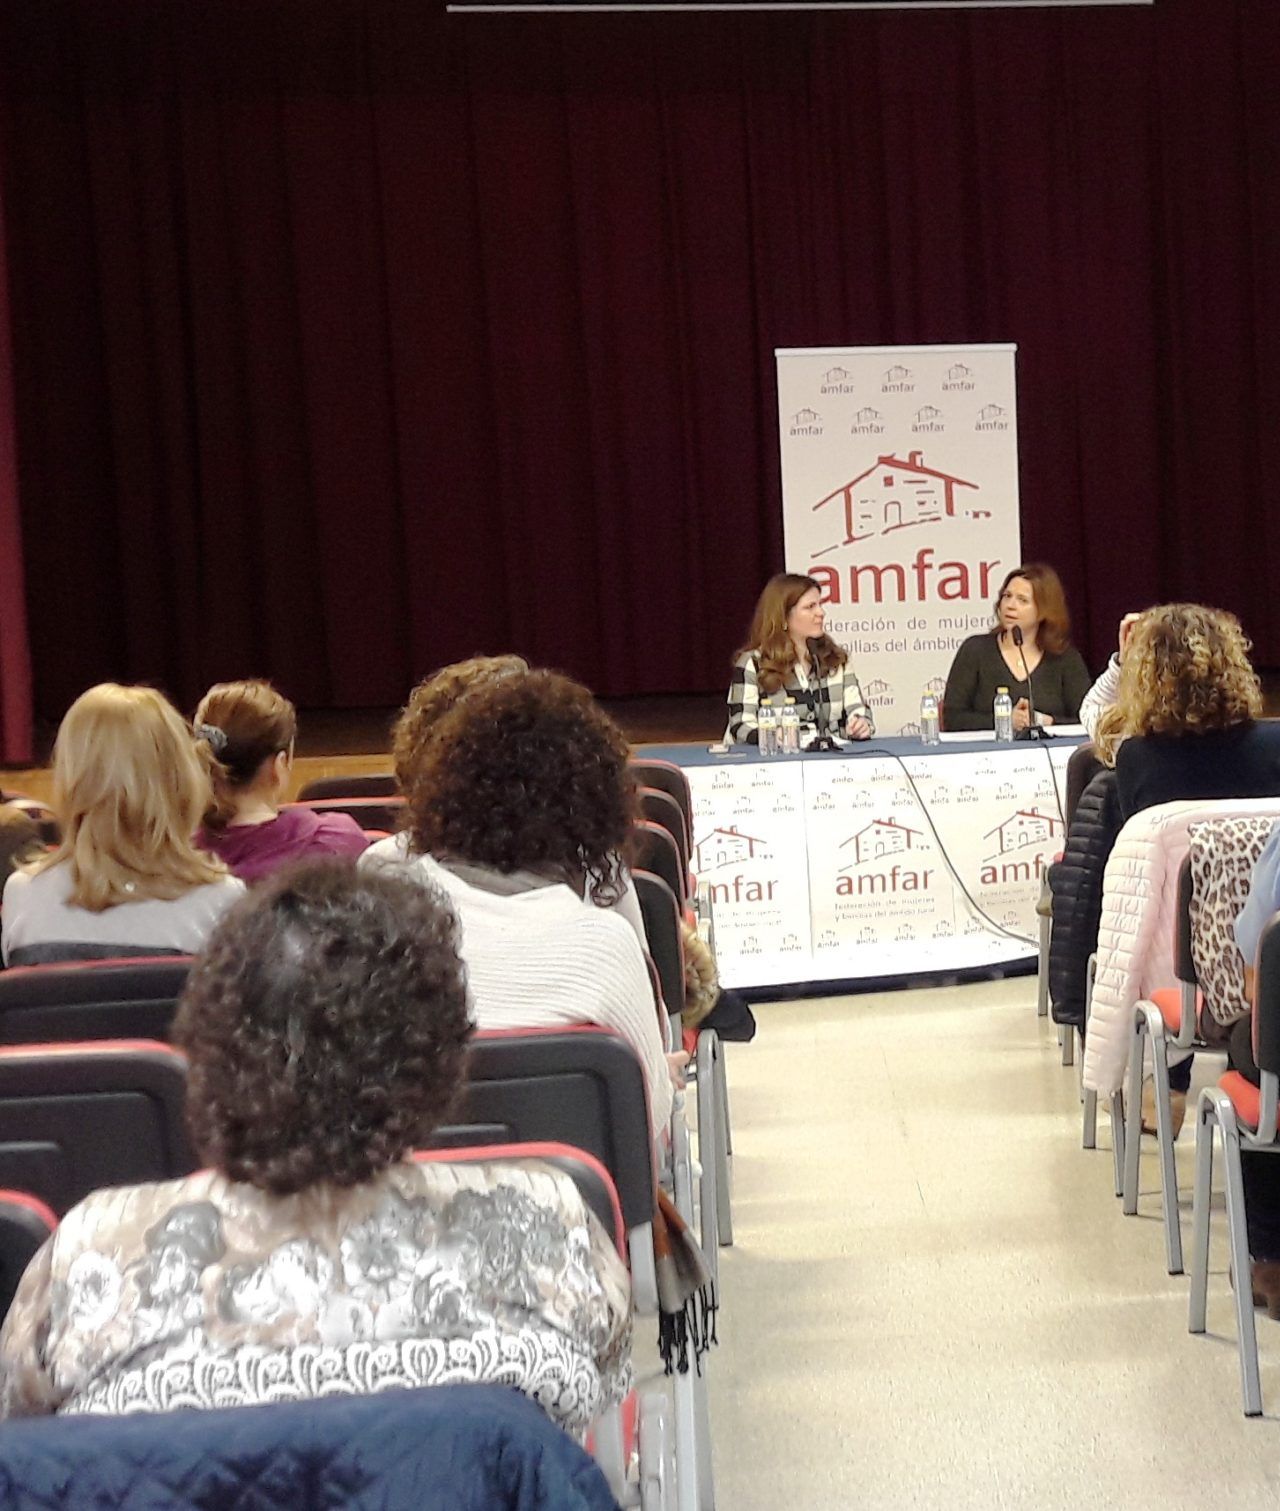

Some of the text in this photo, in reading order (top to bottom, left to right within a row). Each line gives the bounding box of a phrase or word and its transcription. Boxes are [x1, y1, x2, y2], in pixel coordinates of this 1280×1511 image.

[820, 383, 854, 394] amfar
[881, 382, 915, 393] amfar
[942, 380, 976, 391] amfar
[790, 424, 824, 436] amfar
[851, 423, 885, 434] amfar
[912, 422, 945, 433] amfar
[975, 420, 1009, 431] amfar
[807, 548, 1001, 604] amfar
[824, 613, 995, 632] deración de mujere
[885, 638, 907, 652] del
[865, 695, 894, 706] mfar
[980, 853, 1044, 885] amf
[835, 865, 935, 896] amfar
[711, 874, 779, 904] mfar
